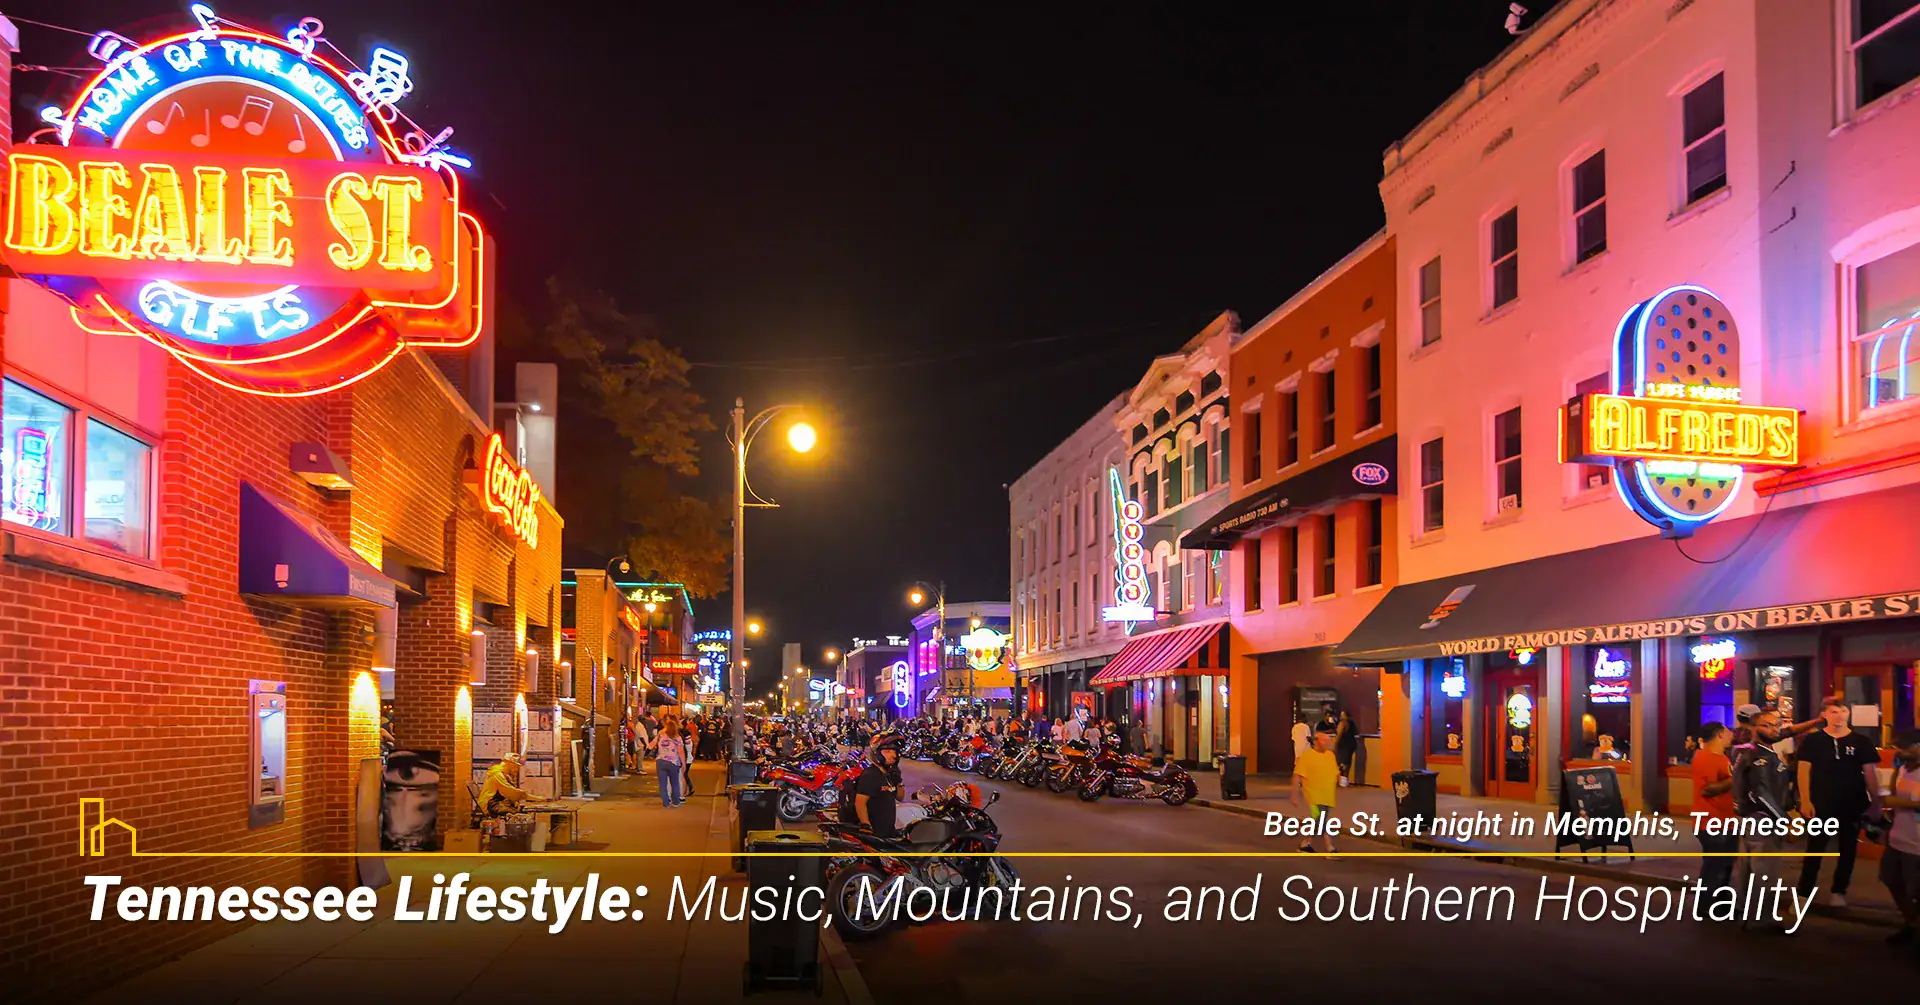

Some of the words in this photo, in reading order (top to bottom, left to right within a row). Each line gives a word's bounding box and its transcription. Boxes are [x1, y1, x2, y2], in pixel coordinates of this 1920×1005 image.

[78, 54, 159, 135] HOME
[164, 42, 208, 72] OF
[220, 40, 282, 75] THE
[285, 63, 370, 150] BLUES
[5, 153, 294, 267] BEALE
[326, 172, 433, 272] ST.
[139, 283, 310, 340] GIFTS
[1598, 397, 1792, 459] ALFRED'S
[1359, 466, 1382, 477] FOX
[1219, 517, 1239, 532] SPORTS
[1239, 510, 1257, 524] RADIO
[1257, 506, 1268, 517] 730
[1268, 502, 1278, 514] AM
[1439, 638, 1500, 656] WORLD
[1503, 629, 1588, 650] FAMOUS
[1591, 618, 1707, 643] ALFRED'S
[1714, 612, 1758, 632] ON
[1765, 599, 1875, 628] BEALE
[652, 661, 671, 669] CLUB
[672, 662, 697, 670] HANDY
